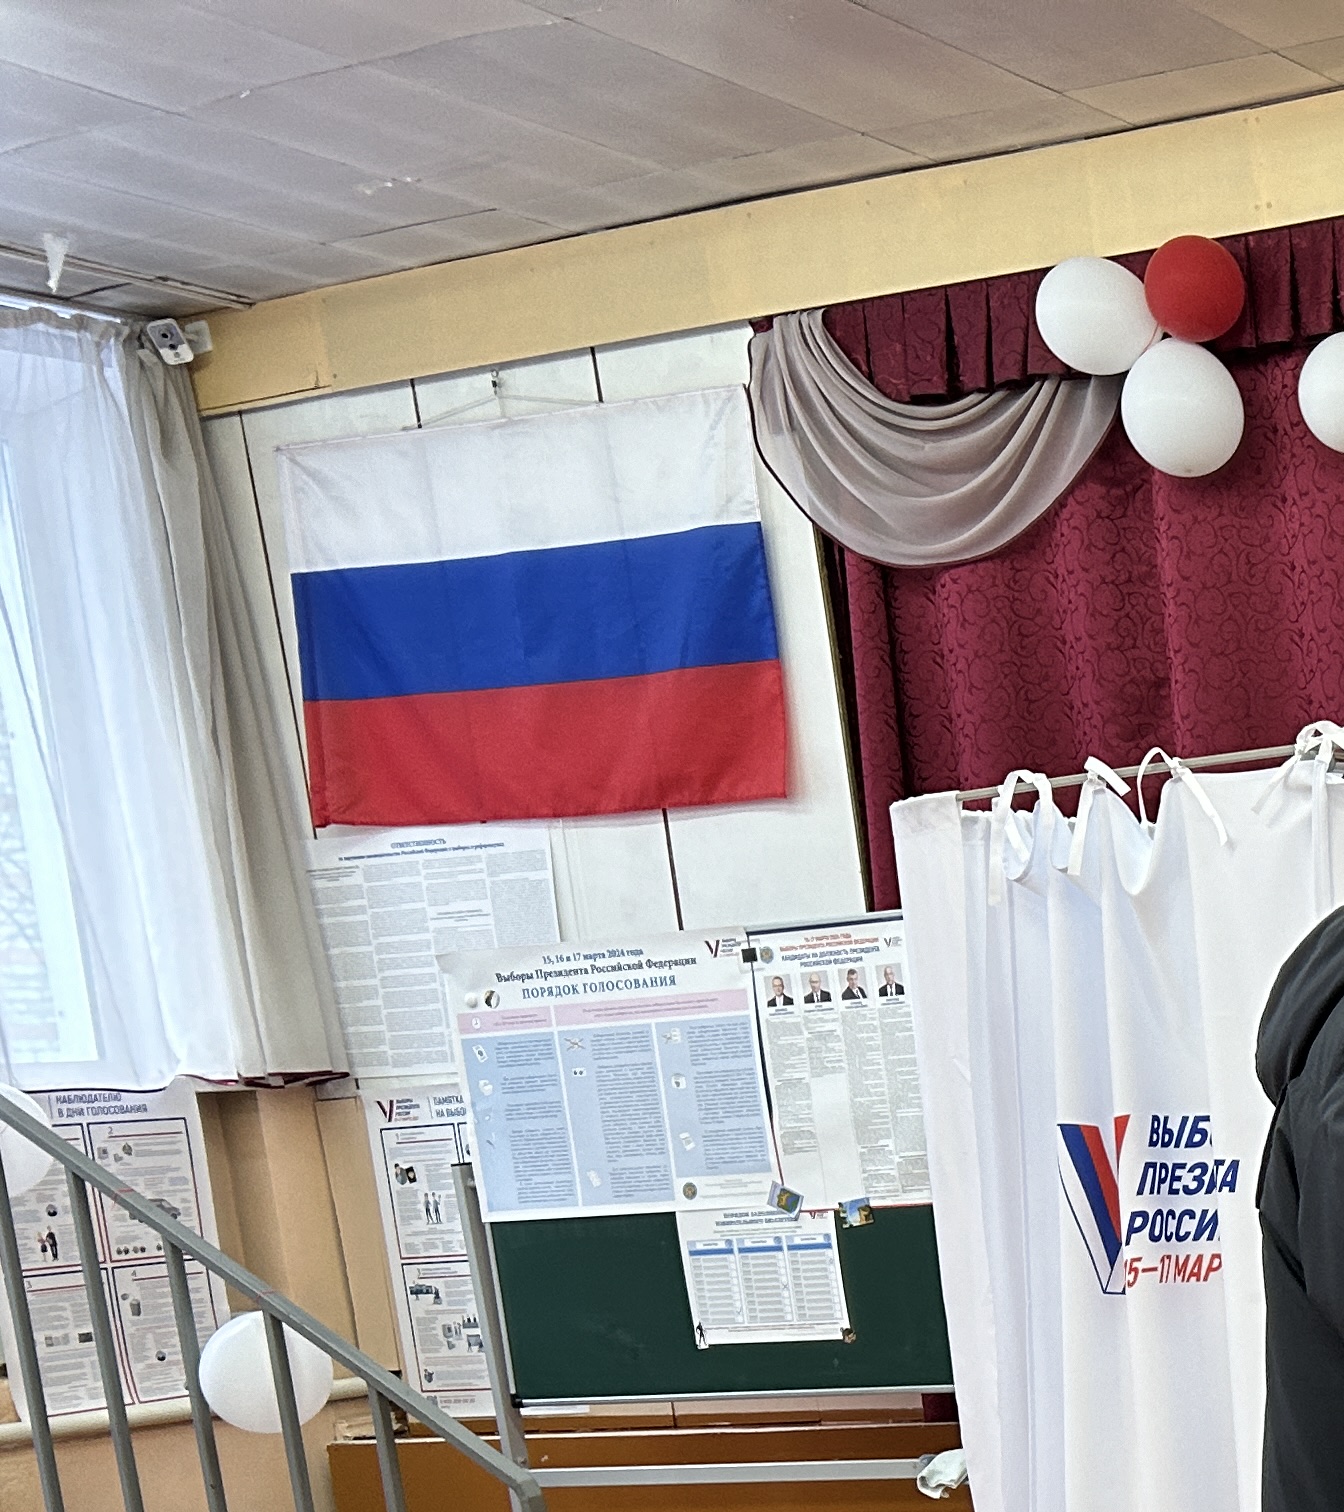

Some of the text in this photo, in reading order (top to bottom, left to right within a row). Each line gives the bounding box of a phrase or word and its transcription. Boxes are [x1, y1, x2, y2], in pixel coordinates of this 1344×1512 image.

[496, 956, 697, 983] Выборы Президента Российской Федерации
[522, 975, 677, 999] ПОРЯДОК ГОЛОСОВАНИЯ
[56, 1092, 122, 1104] НАБЛЮДАТЕЛЮ
[58, 1104, 148, 1118] В ДНИ ГОЛОСОВАНИЯ
[1148, 1114, 1213, 1149] ВЫБ
